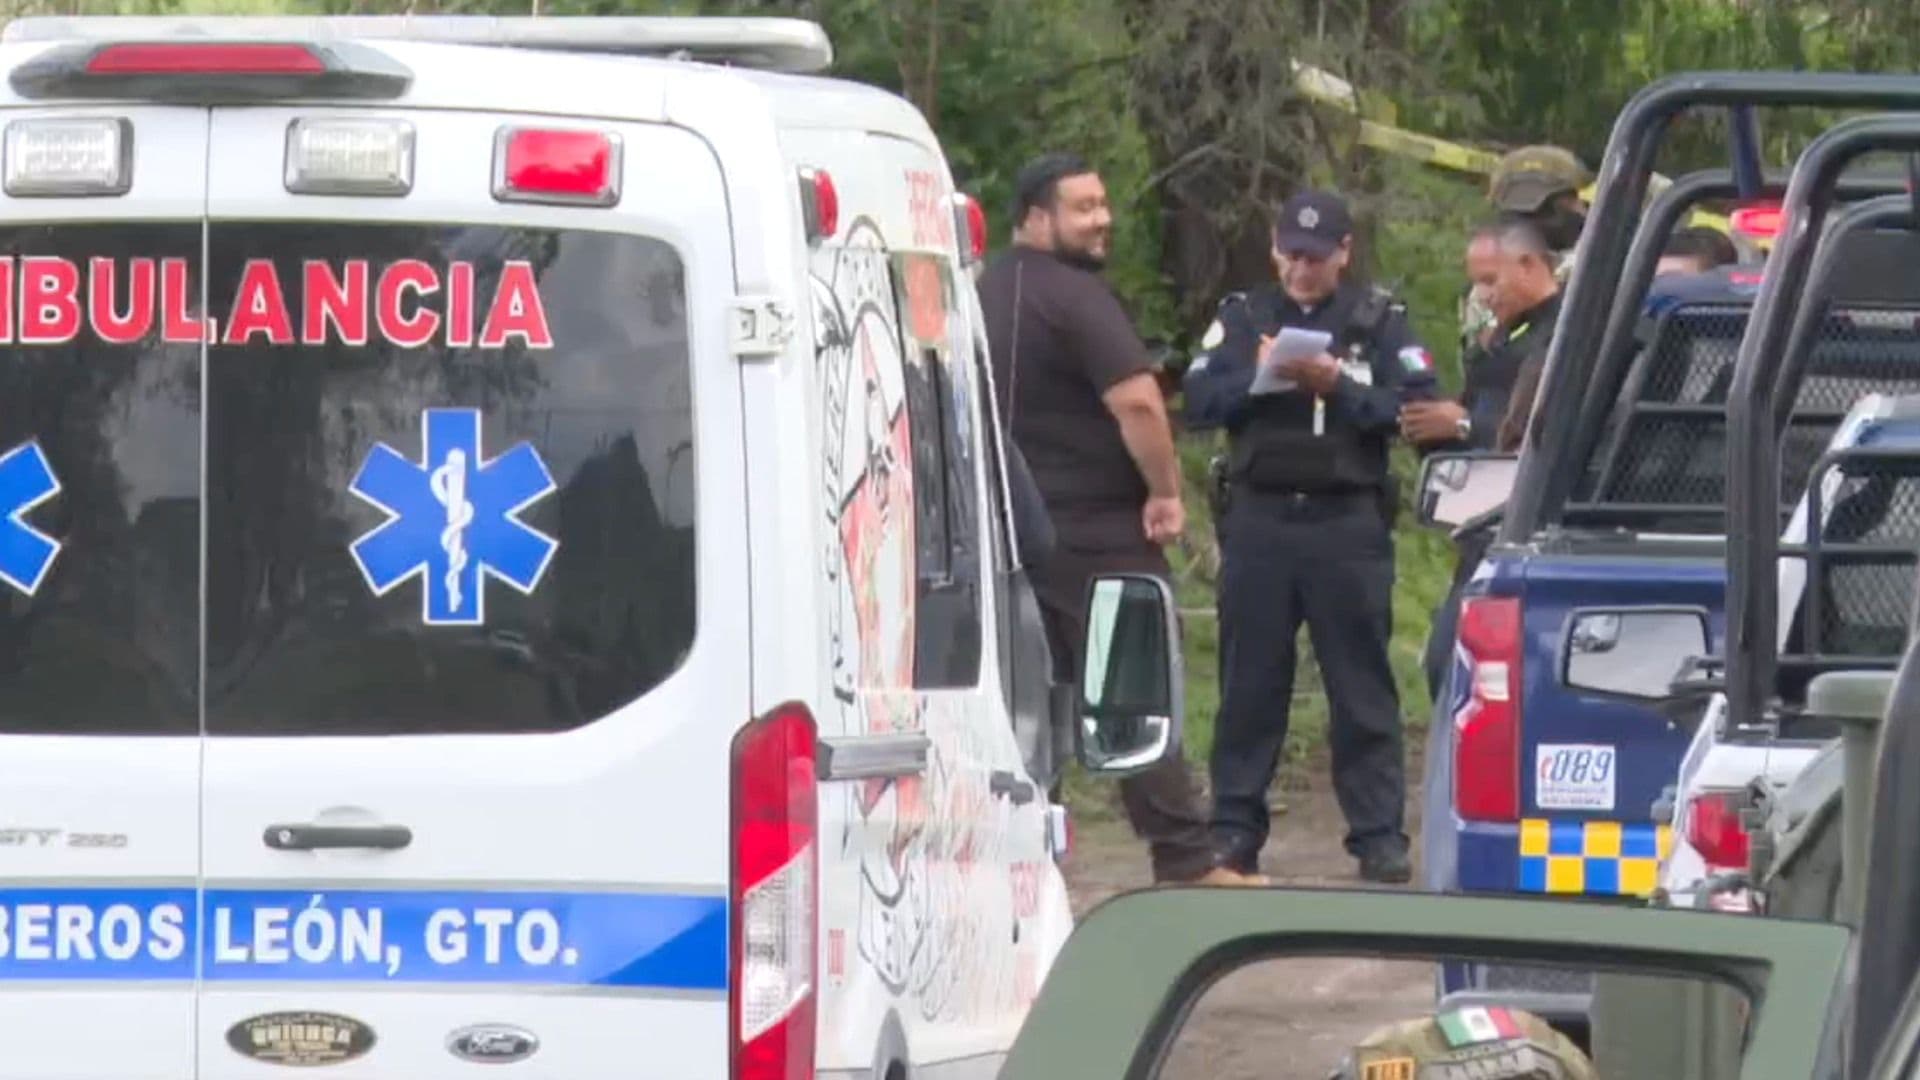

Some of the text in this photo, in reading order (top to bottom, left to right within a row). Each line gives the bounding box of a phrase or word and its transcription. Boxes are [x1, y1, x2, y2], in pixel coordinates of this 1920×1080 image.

[0, 255, 554, 348] BULANCIA
[1550, 749, 1613, 784] 089
[0, 894, 579, 977] EROS LEÓN, GTO.
